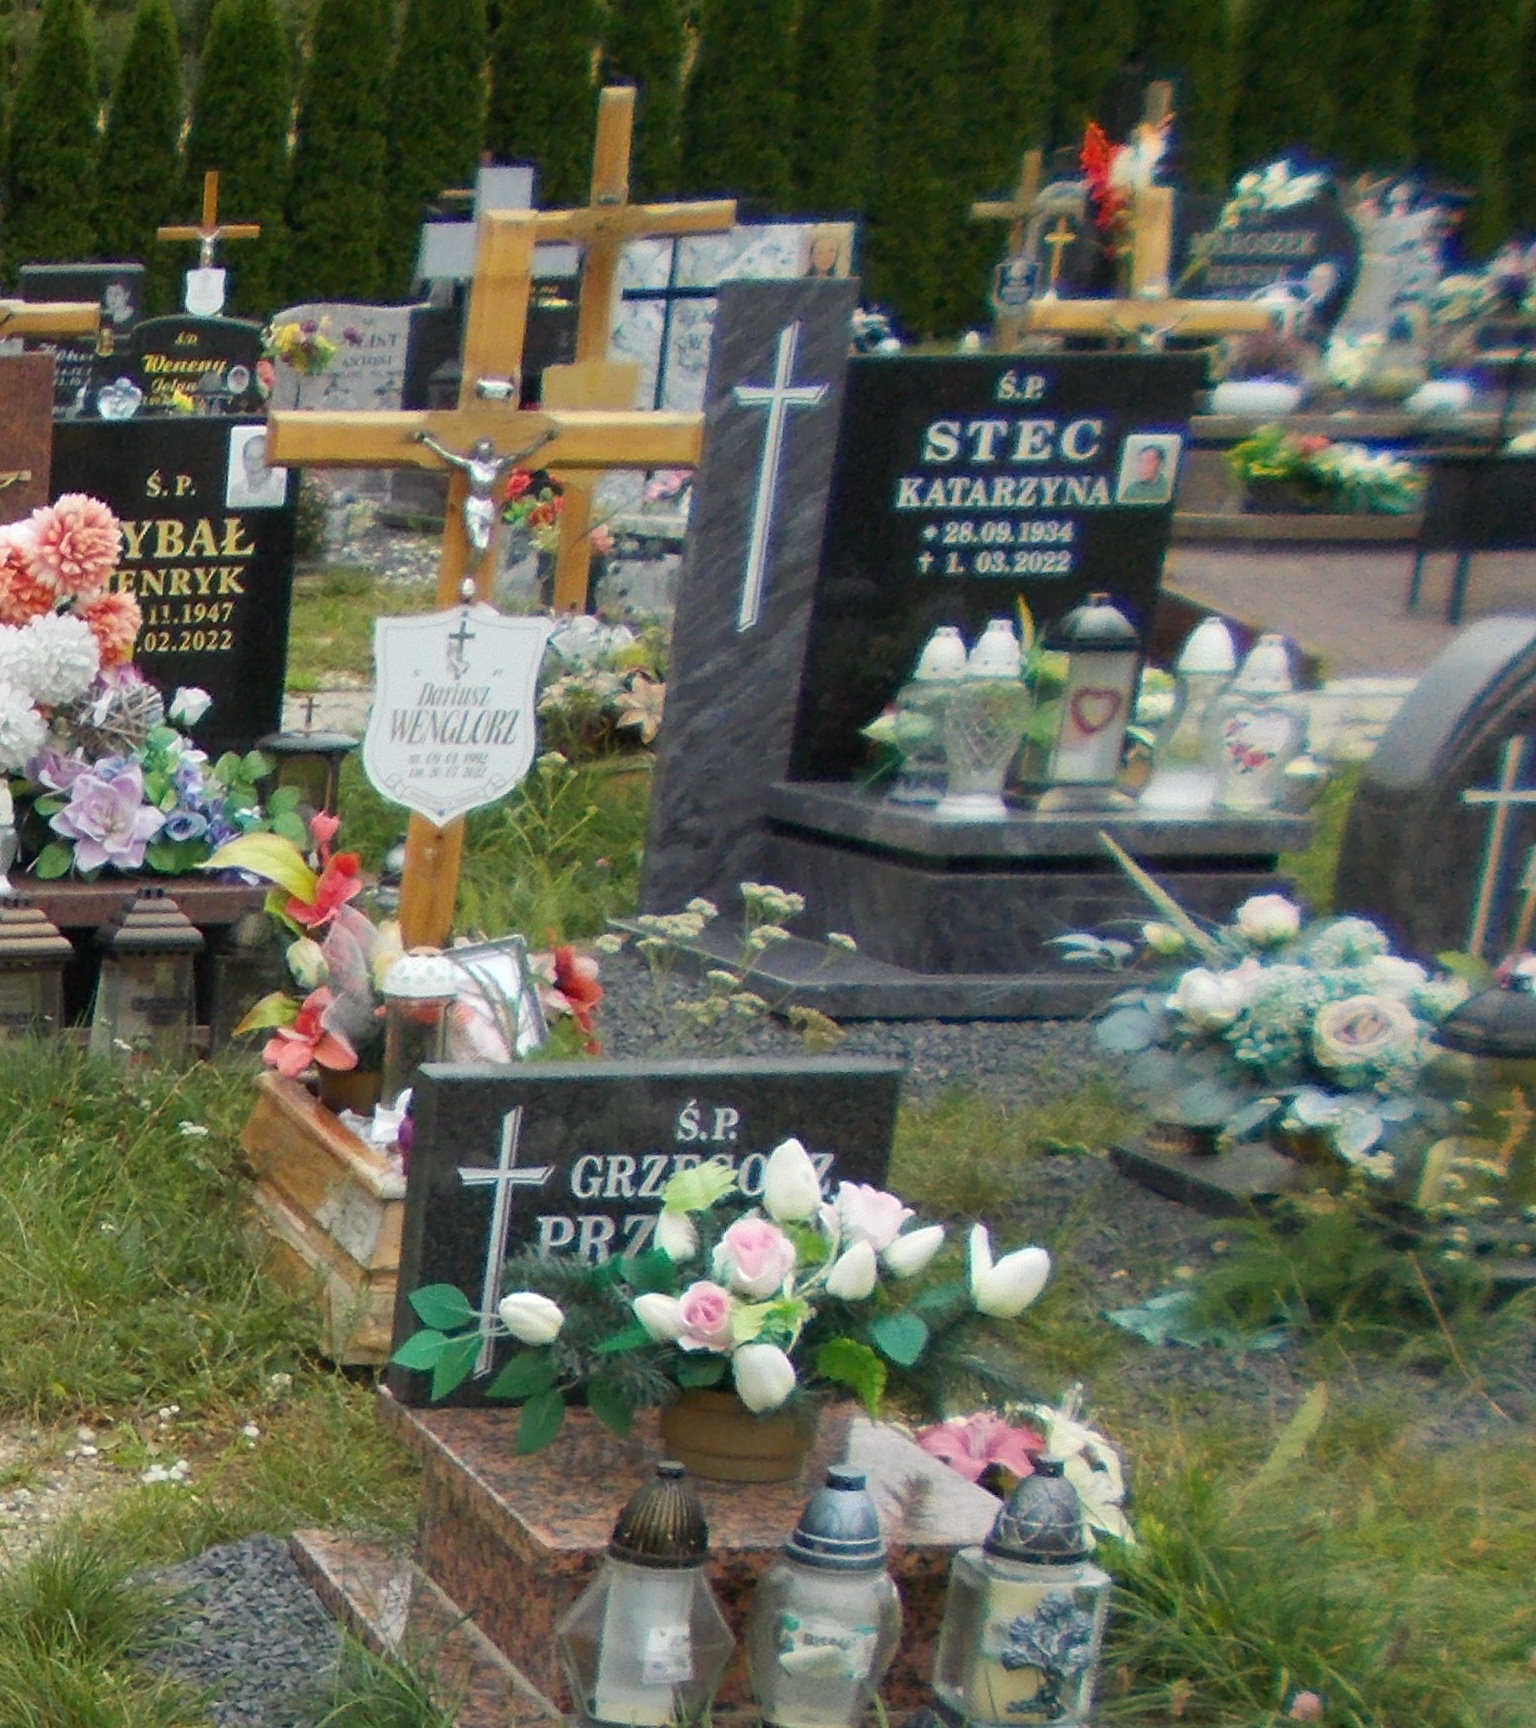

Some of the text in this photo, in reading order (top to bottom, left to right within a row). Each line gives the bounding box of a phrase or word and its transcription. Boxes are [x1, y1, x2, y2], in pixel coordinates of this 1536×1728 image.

[925, 419, 1104, 461] STEC
[896, 476, 1111, 507] KATARZYNA
[120, 516, 255, 558] YBAŁ
[417, 682, 491, 706] Dariusz
[390, 709, 521, 745] WENGLORZ
